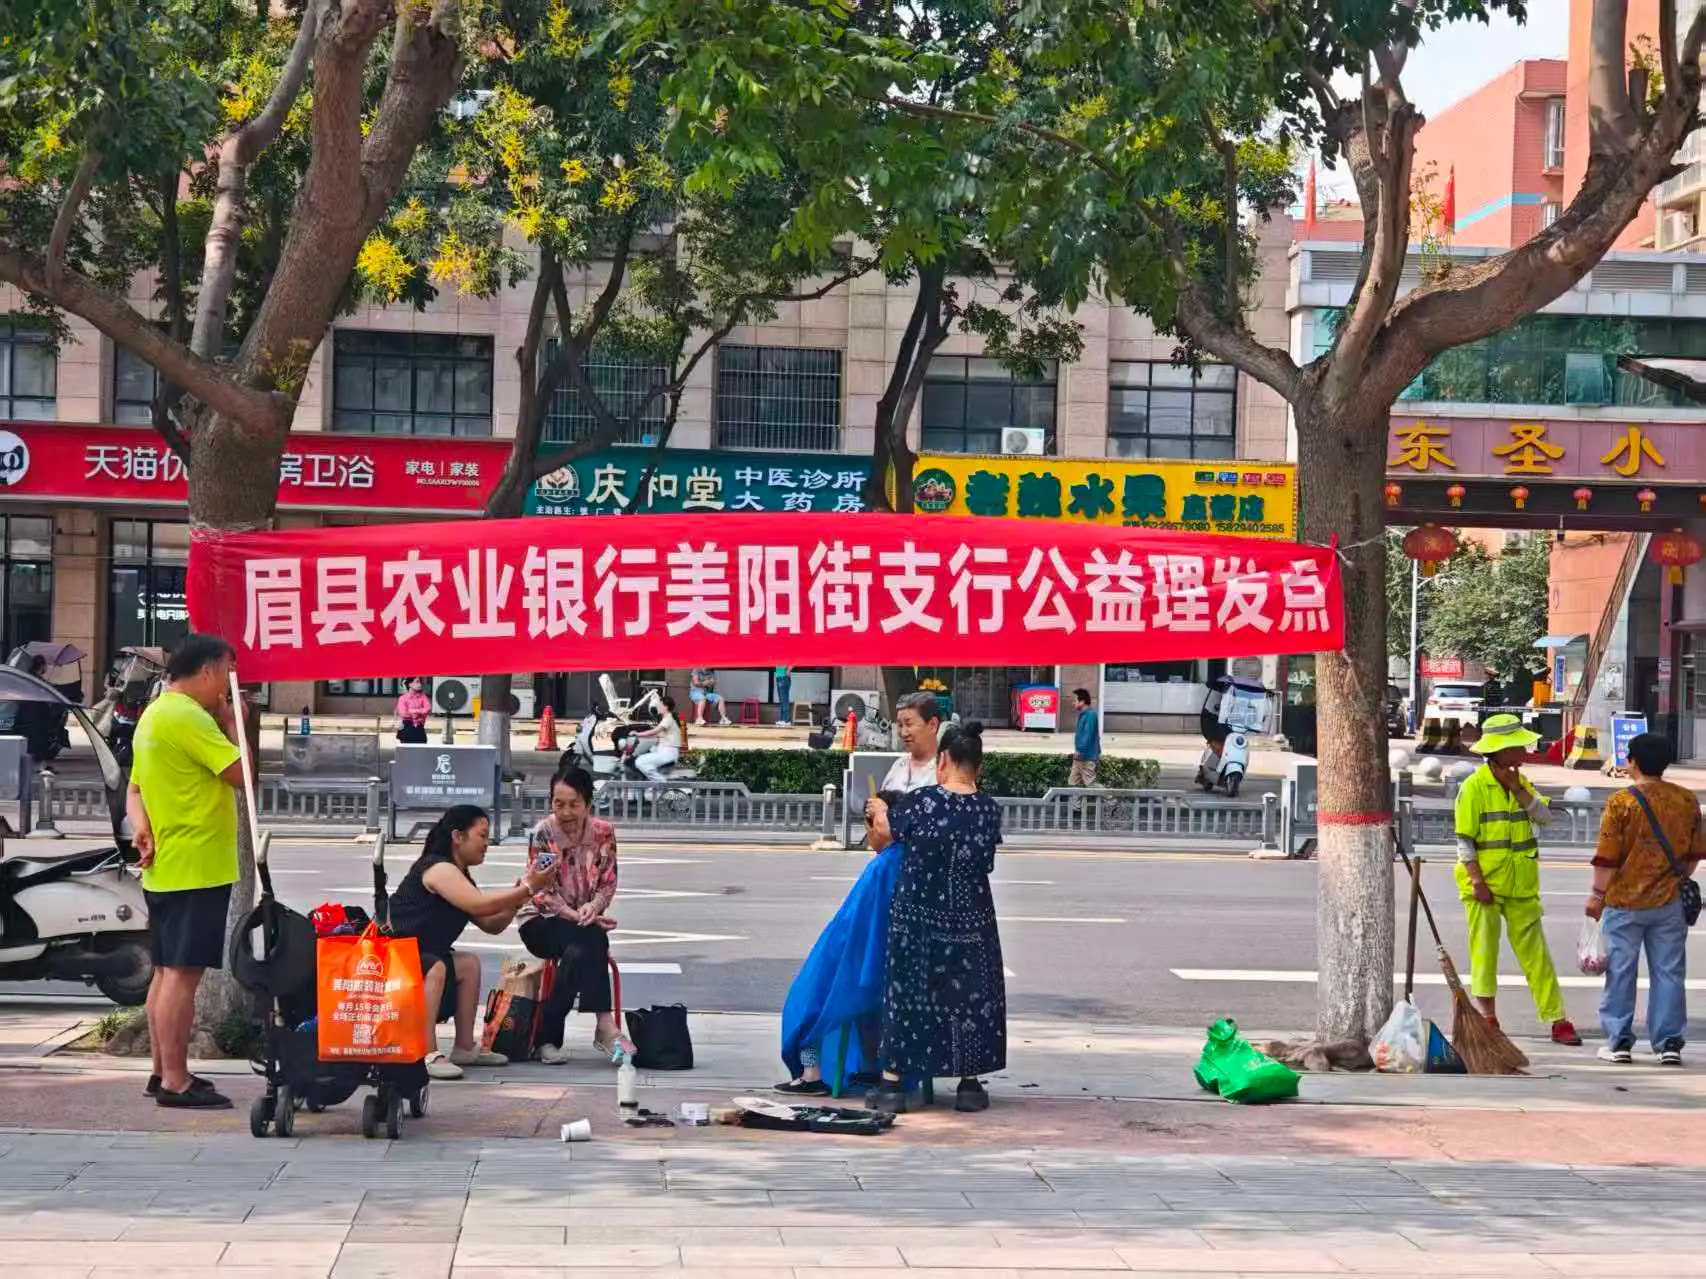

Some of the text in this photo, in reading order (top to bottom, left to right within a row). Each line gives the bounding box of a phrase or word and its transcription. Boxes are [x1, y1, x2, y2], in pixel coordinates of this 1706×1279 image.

[1389, 422, 1666, 477] 东圣小
[405, 460, 480, 477] 家电 家装
[585, 462, 725, 511] 庆和堂
[734, 466, 867, 492] 中医诊所
[730, 490, 866, 514] 大药房
[242, 540, 1331, 650] 眉县农业银行美阳街支行公益理发点
